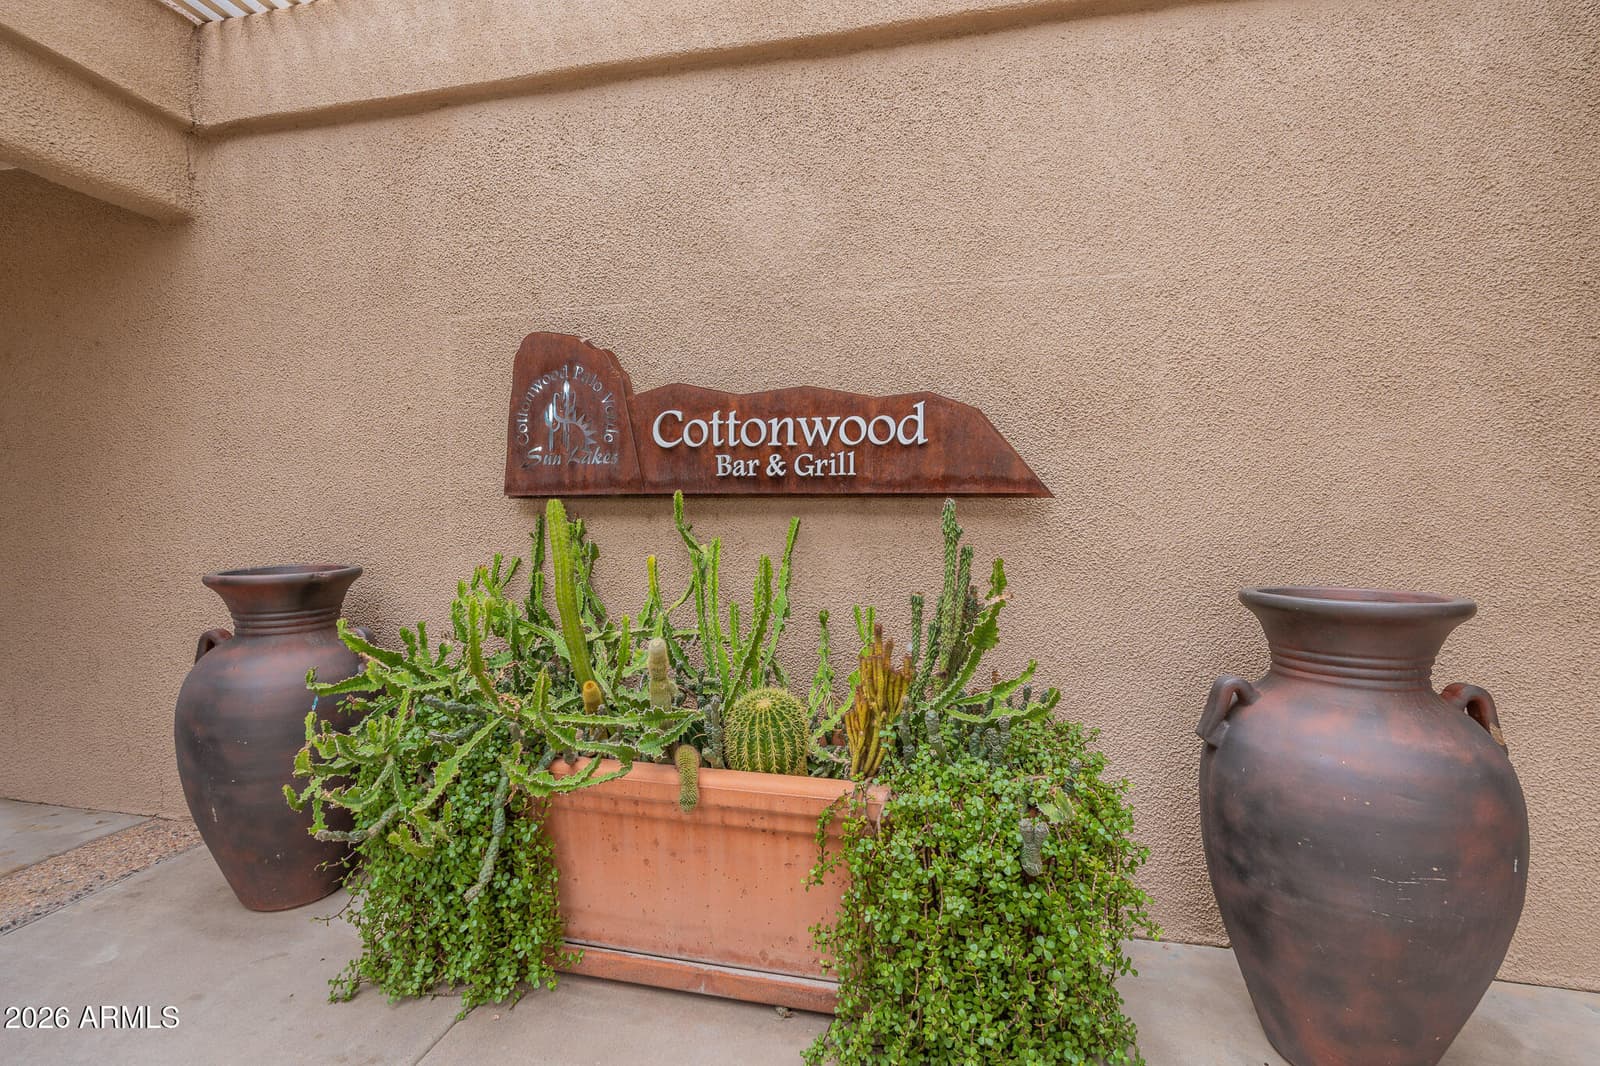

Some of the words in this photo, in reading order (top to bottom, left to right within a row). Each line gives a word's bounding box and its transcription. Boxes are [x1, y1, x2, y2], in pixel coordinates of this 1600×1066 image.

[516, 364, 569, 446] Cottonwood
[573, 365, 603, 392] Palo
[652, 400, 928, 448] Cottonwood
[521, 446, 561, 468] Sun
[567, 447, 619, 466] Lakes
[715, 454, 760, 477] Bar
[766, 454, 787, 477] &
[794, 451, 857, 476] Grill
